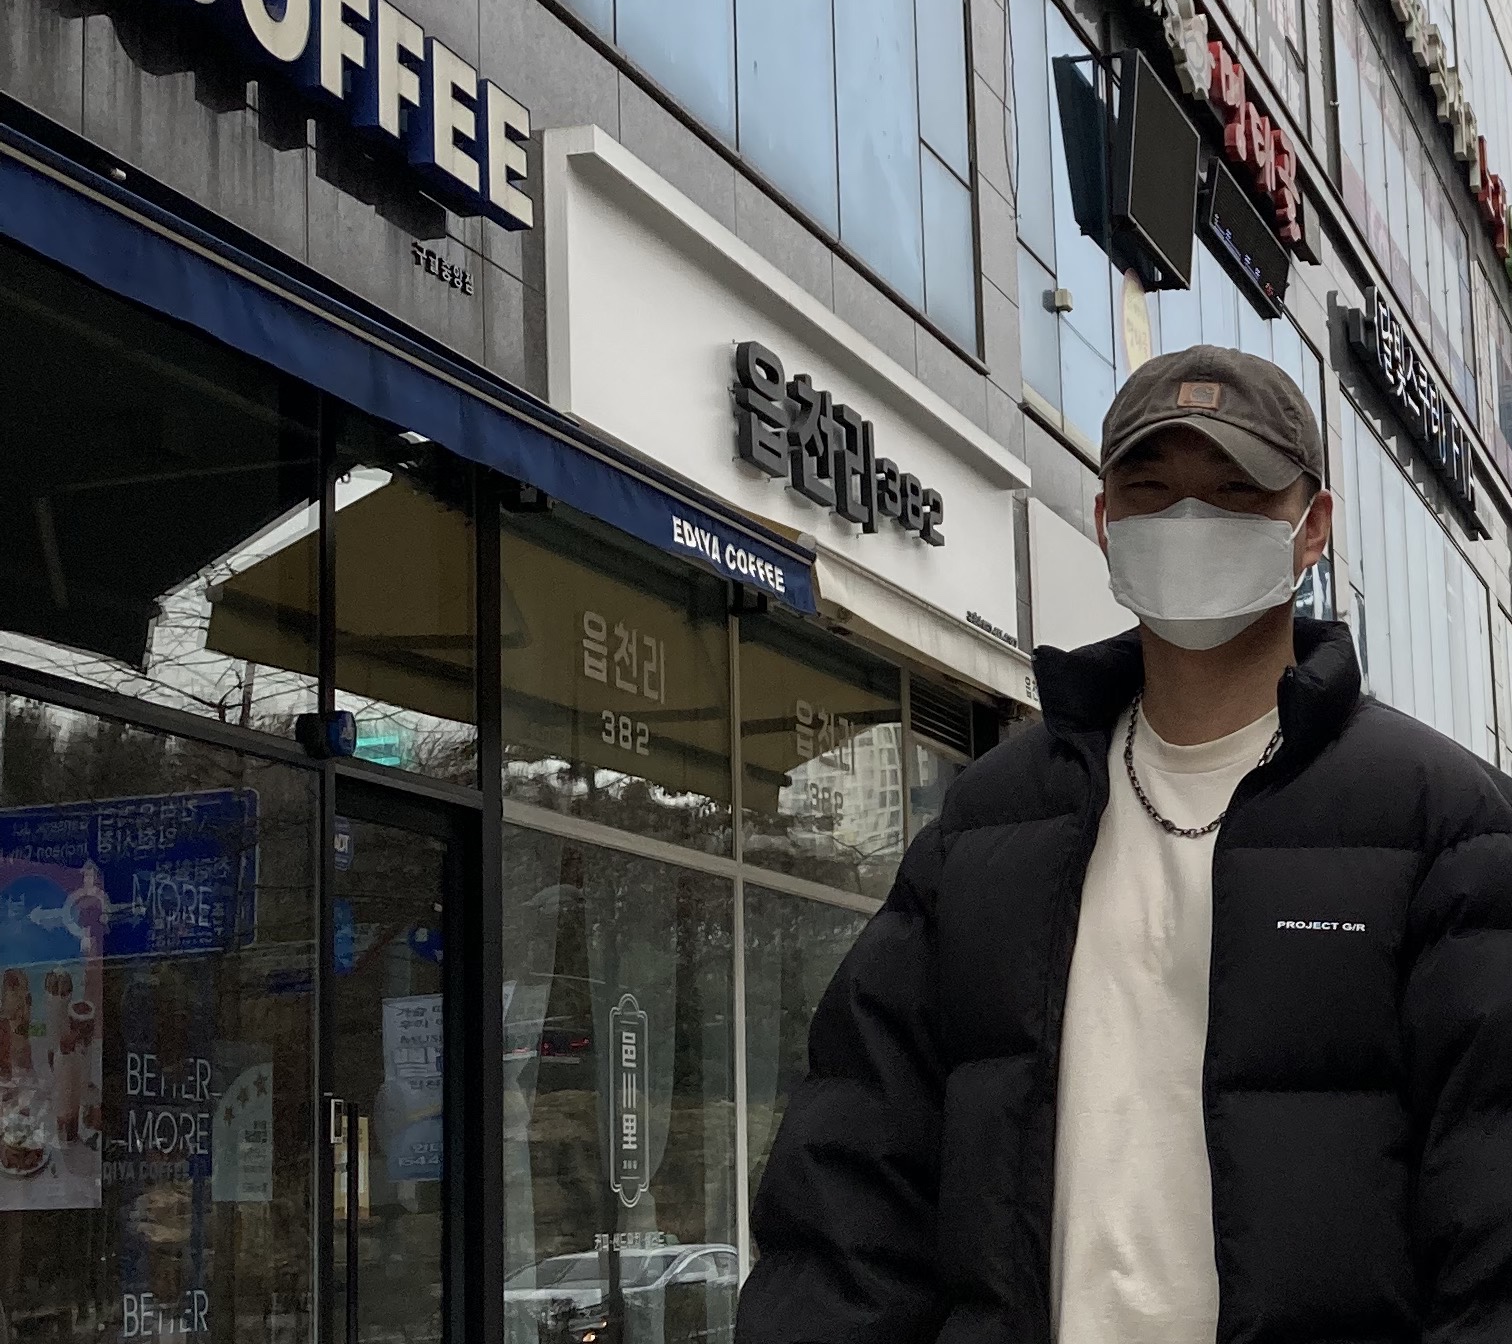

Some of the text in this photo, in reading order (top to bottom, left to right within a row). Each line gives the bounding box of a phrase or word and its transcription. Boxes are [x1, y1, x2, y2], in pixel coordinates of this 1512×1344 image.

[411, 242, 475, 295] 구월중앙점
[671, 514, 787, 594] EDIYA COFFEE
[583, 609, 666, 705] 읍천리
[601, 710, 650, 756] 382
[1277, 921, 1339, 930] PROJECT
[129, 1112, 210, 1155] MORE
